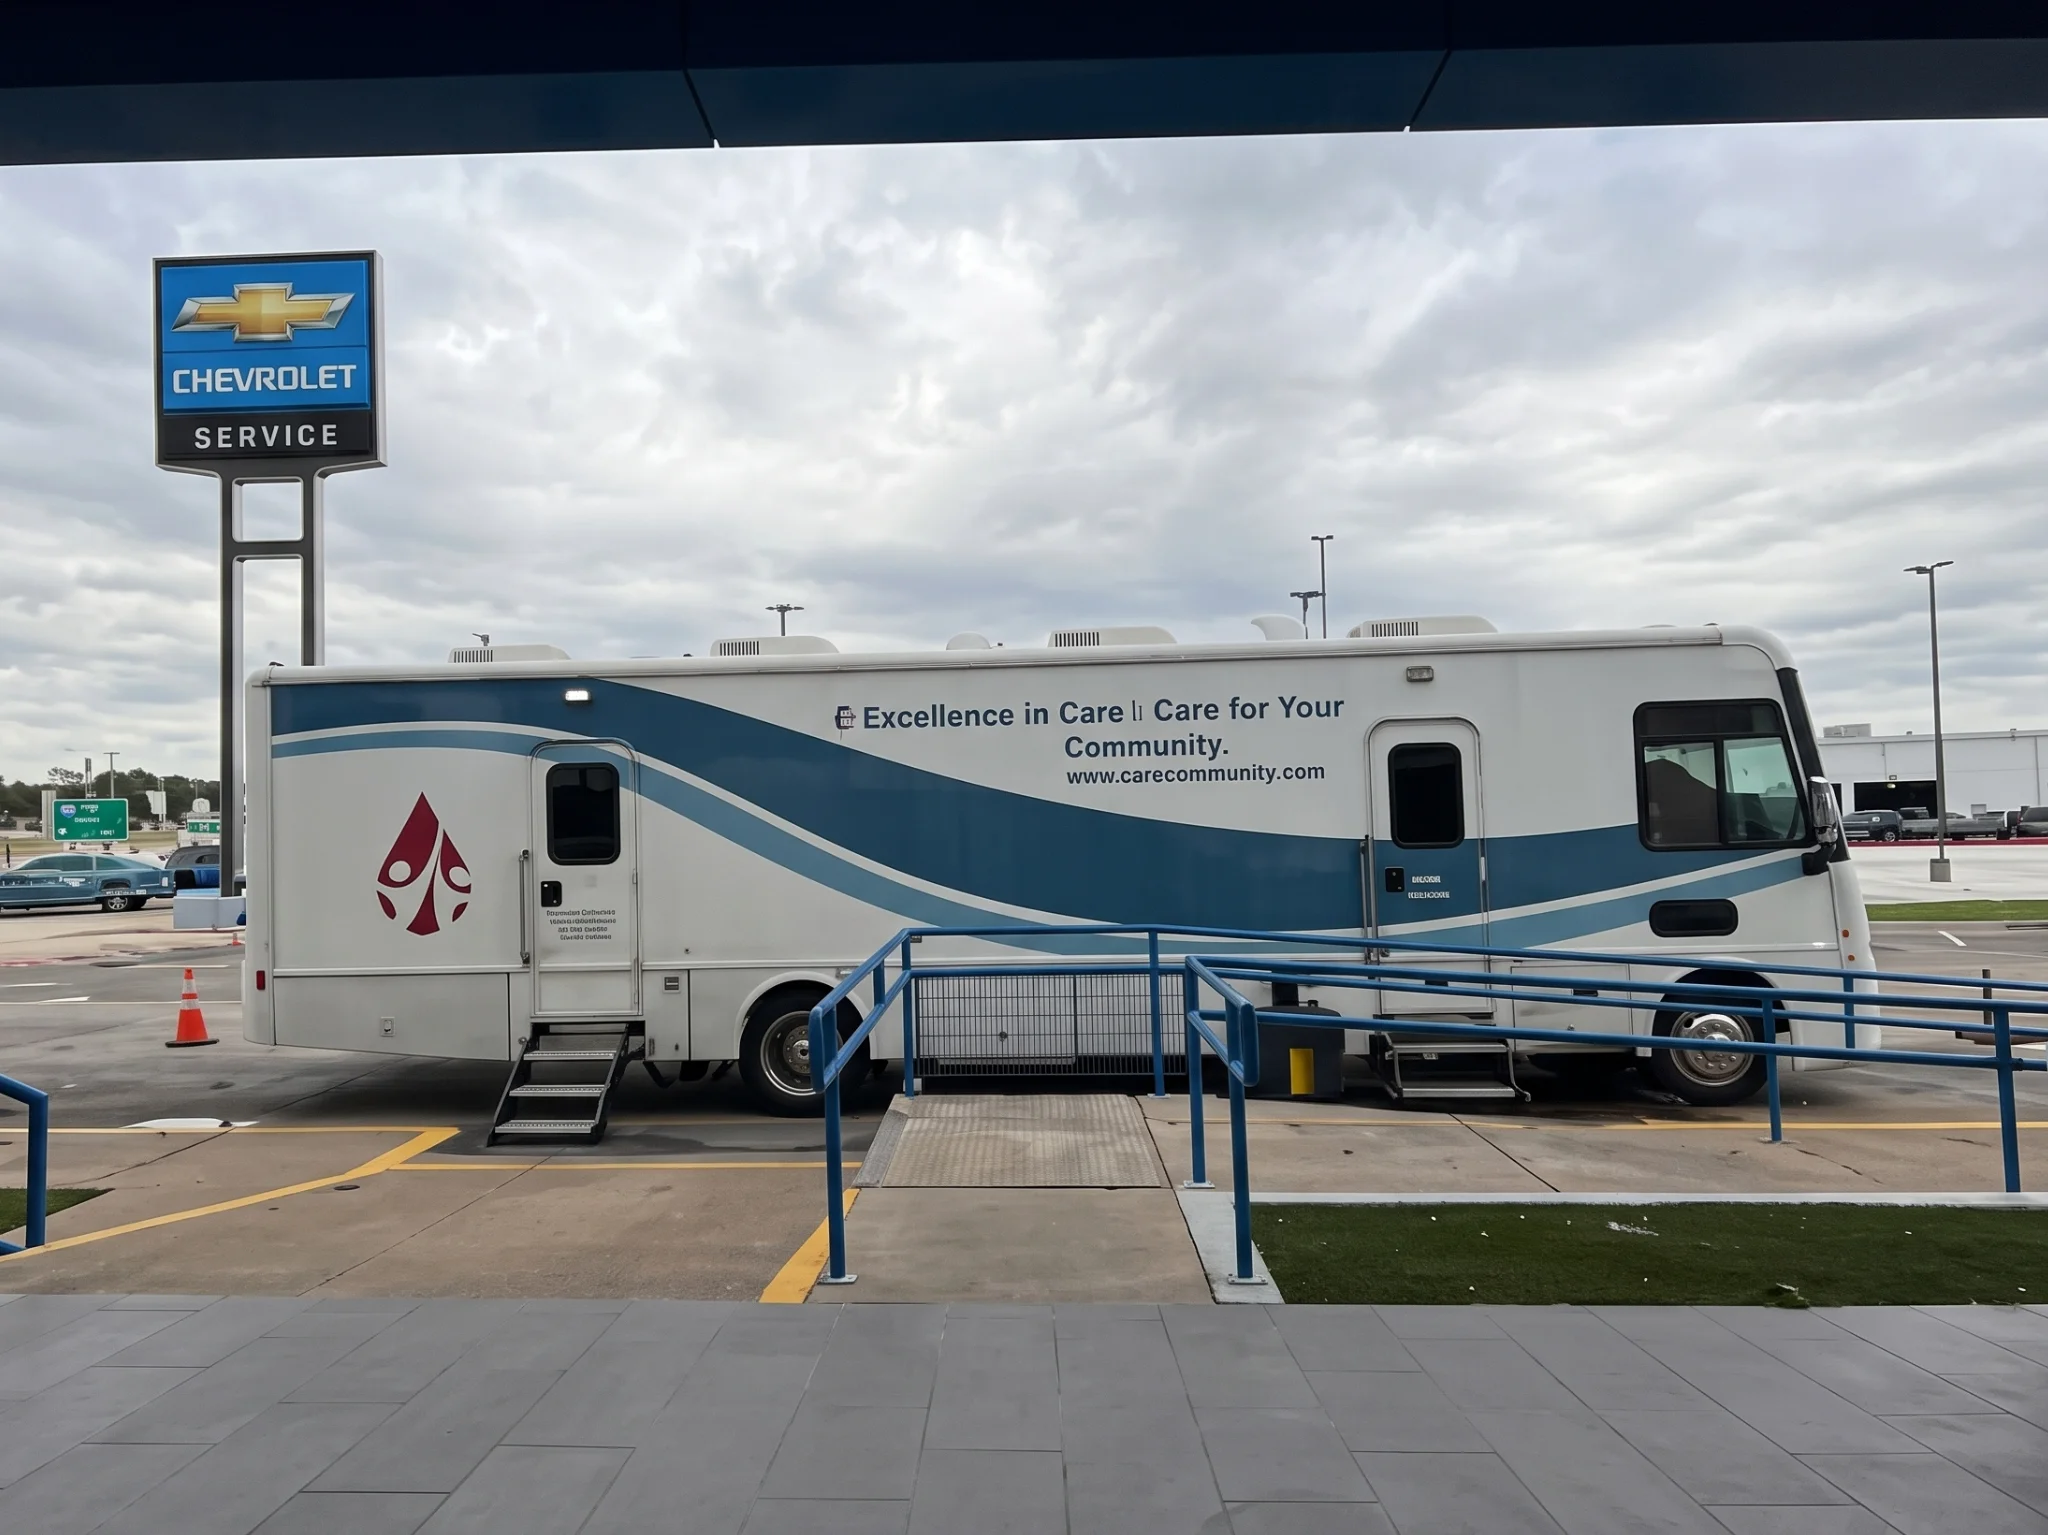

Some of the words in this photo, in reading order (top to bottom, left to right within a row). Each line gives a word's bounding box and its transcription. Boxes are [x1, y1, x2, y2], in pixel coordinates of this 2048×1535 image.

[172, 364, 357, 394] CHEVROLET
[194, 424, 338, 449] SERVICE
[863, 703, 1015, 729] Excellence
[1024, 702, 1049, 725] in
[1059, 701, 1124, 724] Care
[1153, 698, 1219, 722] Care
[1228, 696, 1270, 720] for
[1277, 695, 1345, 719] Your
[1064, 732, 1229, 762] Community.
[1066, 763, 1325, 785] www.carecommunity.com
